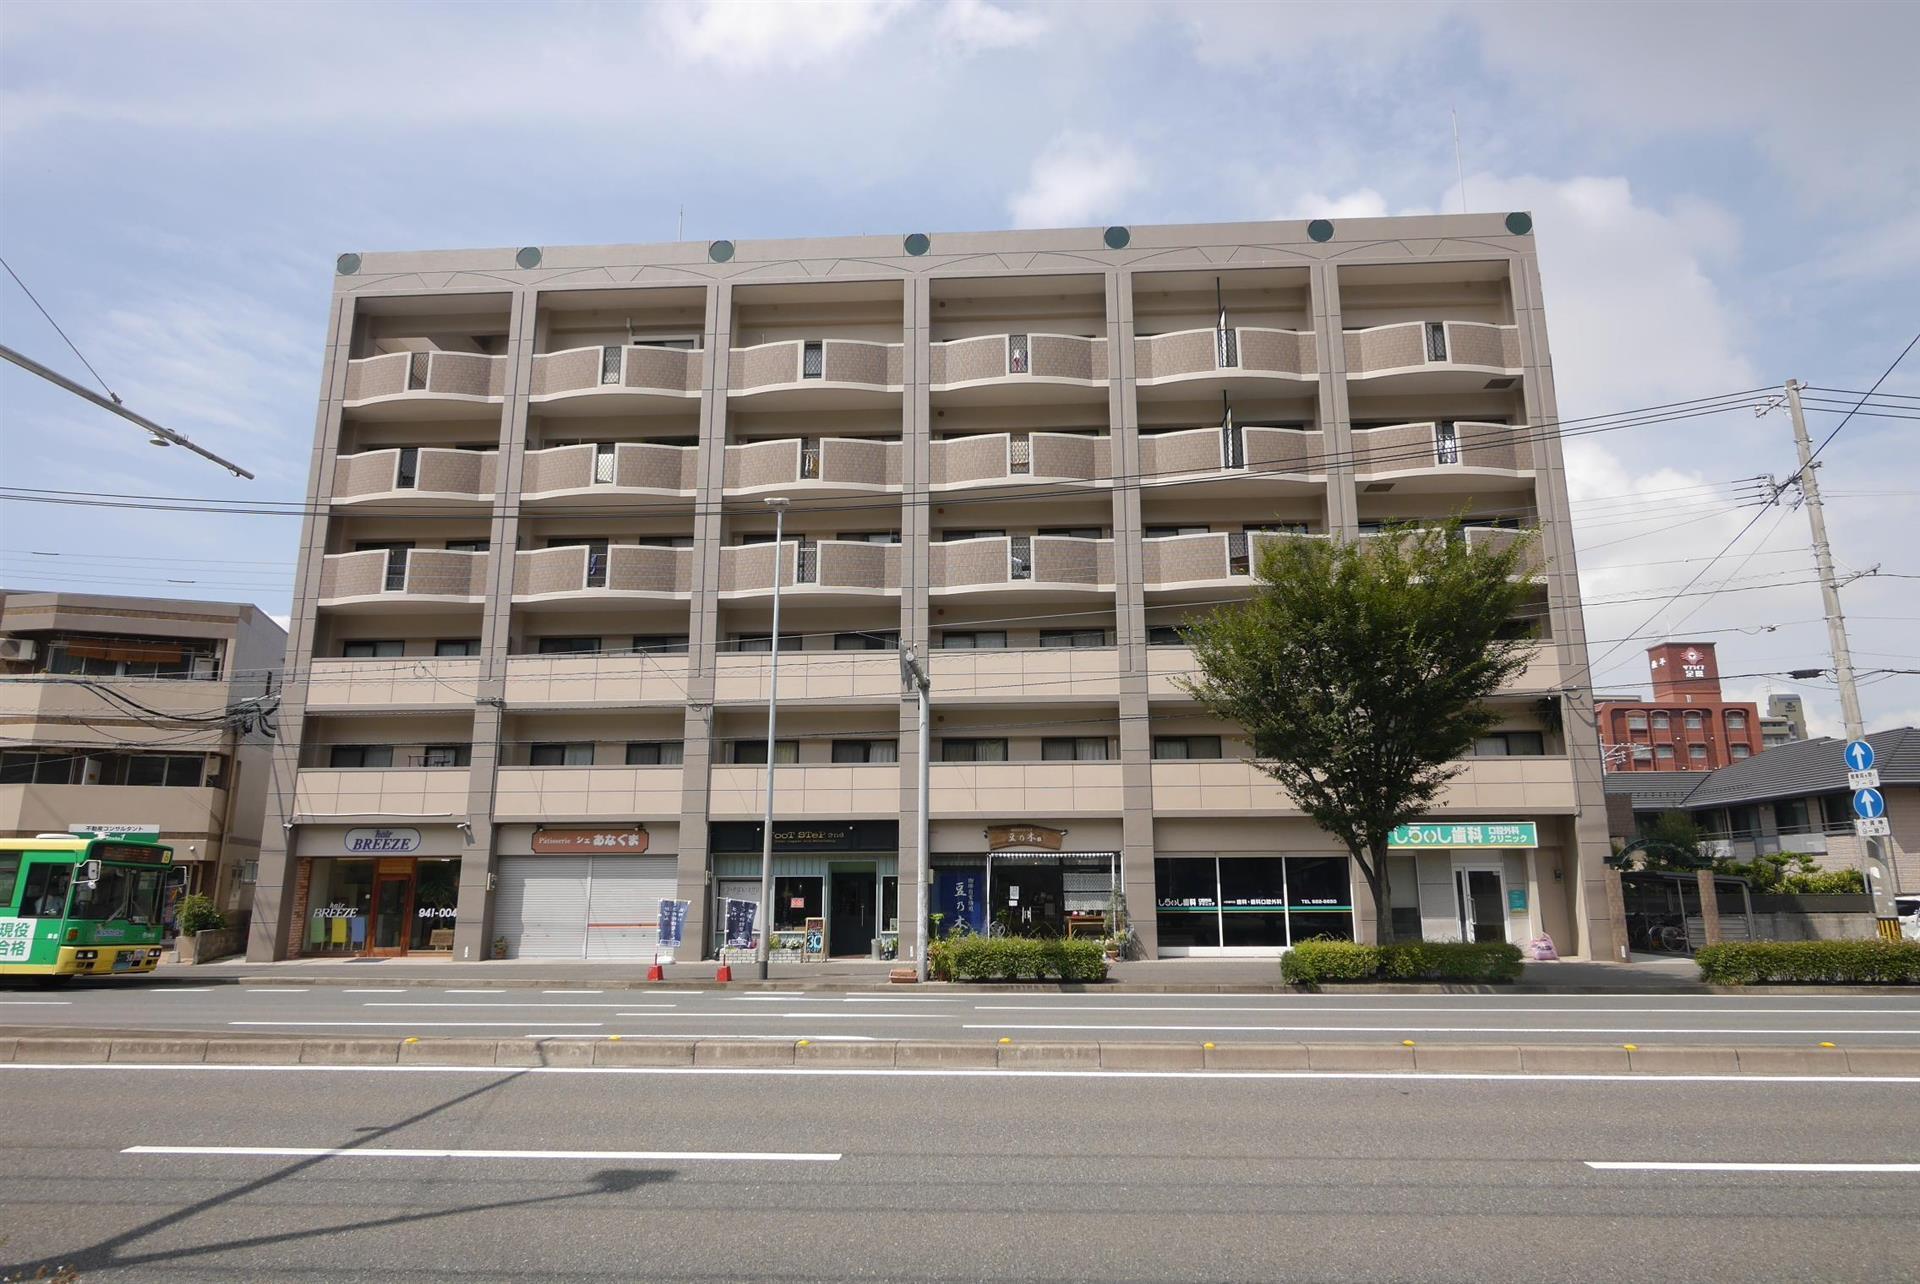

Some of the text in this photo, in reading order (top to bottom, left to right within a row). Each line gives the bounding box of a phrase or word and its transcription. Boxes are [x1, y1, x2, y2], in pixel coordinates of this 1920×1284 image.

[375, 829, 393, 839] hair
[593, 834, 639, 846] あなぐま
[1489, 834, 1528, 843] クリニック
[353, 838, 412, 850] BREEZE
[313, 908, 358, 918] BREEZE
[0, 922, 30, 937] 現役
[0, 940, 26, 956] 合格
